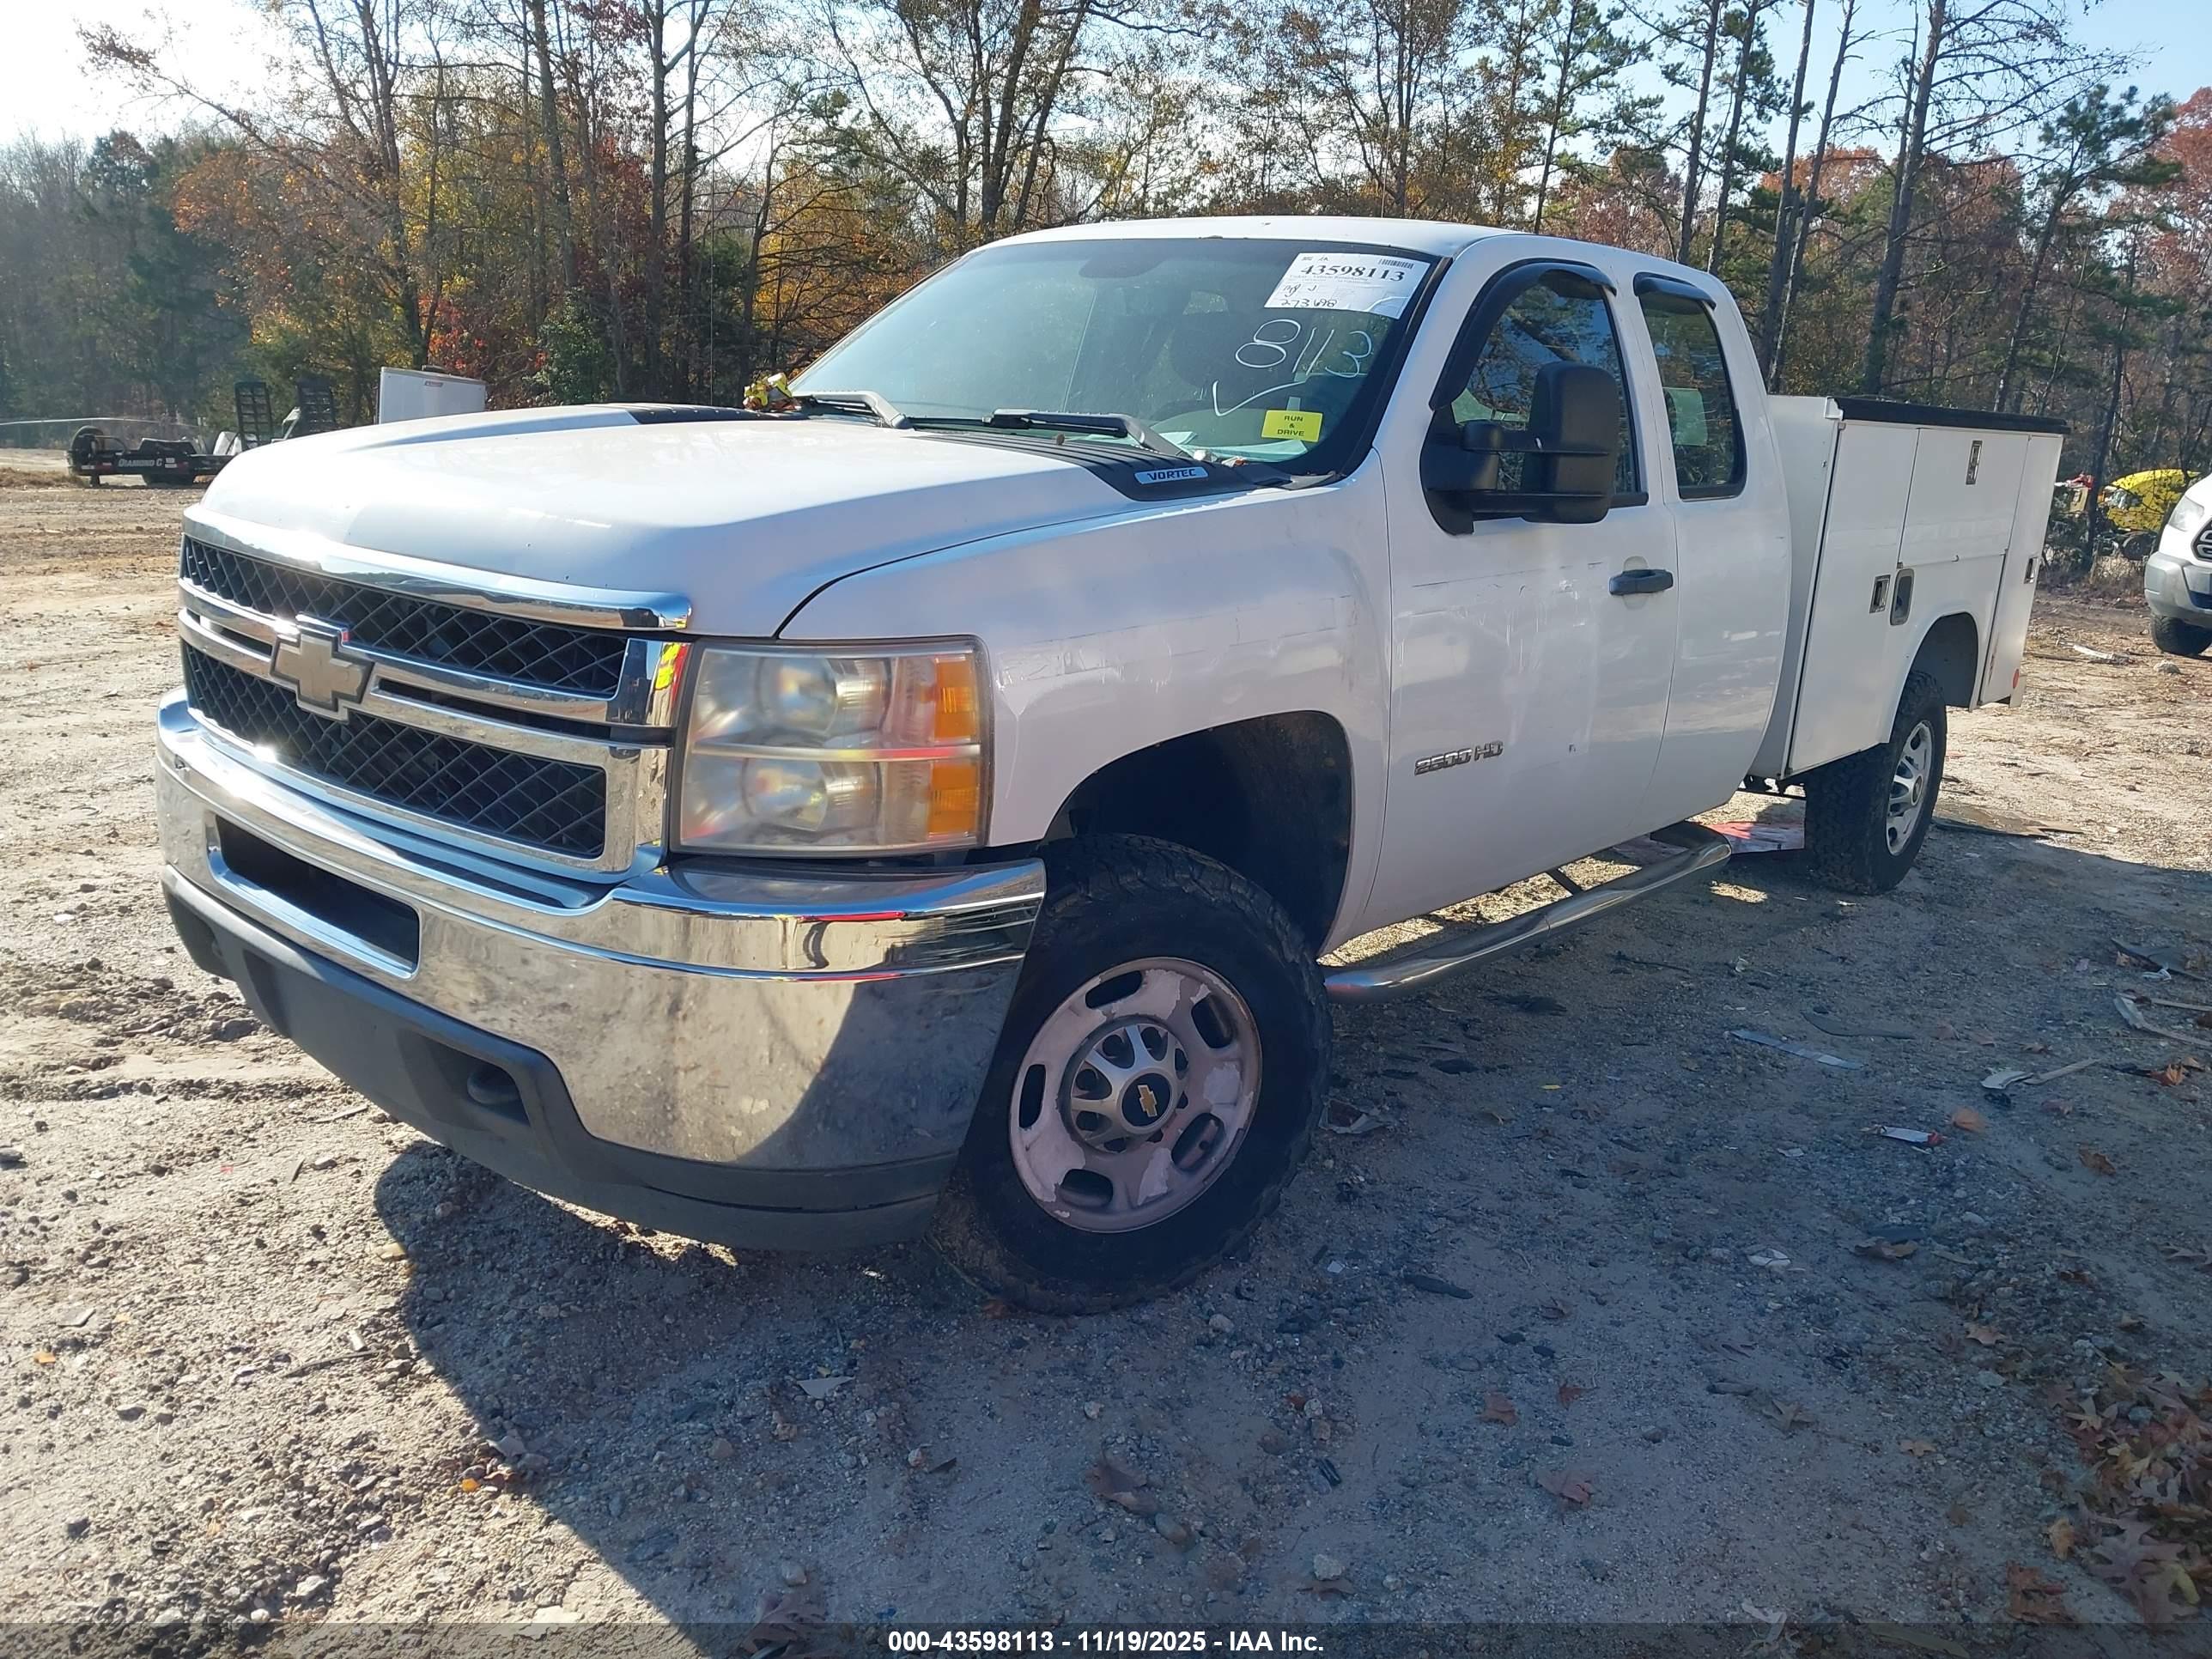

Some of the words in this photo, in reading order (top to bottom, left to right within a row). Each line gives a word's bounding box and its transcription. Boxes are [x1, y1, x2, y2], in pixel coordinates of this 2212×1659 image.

[1301, 264, 1405, 282] 43598113
[1235, 319, 1372, 378] 8113
[155, 458, 162, 466] C
[1147, 468, 1197, 481] VORTEC
[1474, 739, 1504, 762] HD
